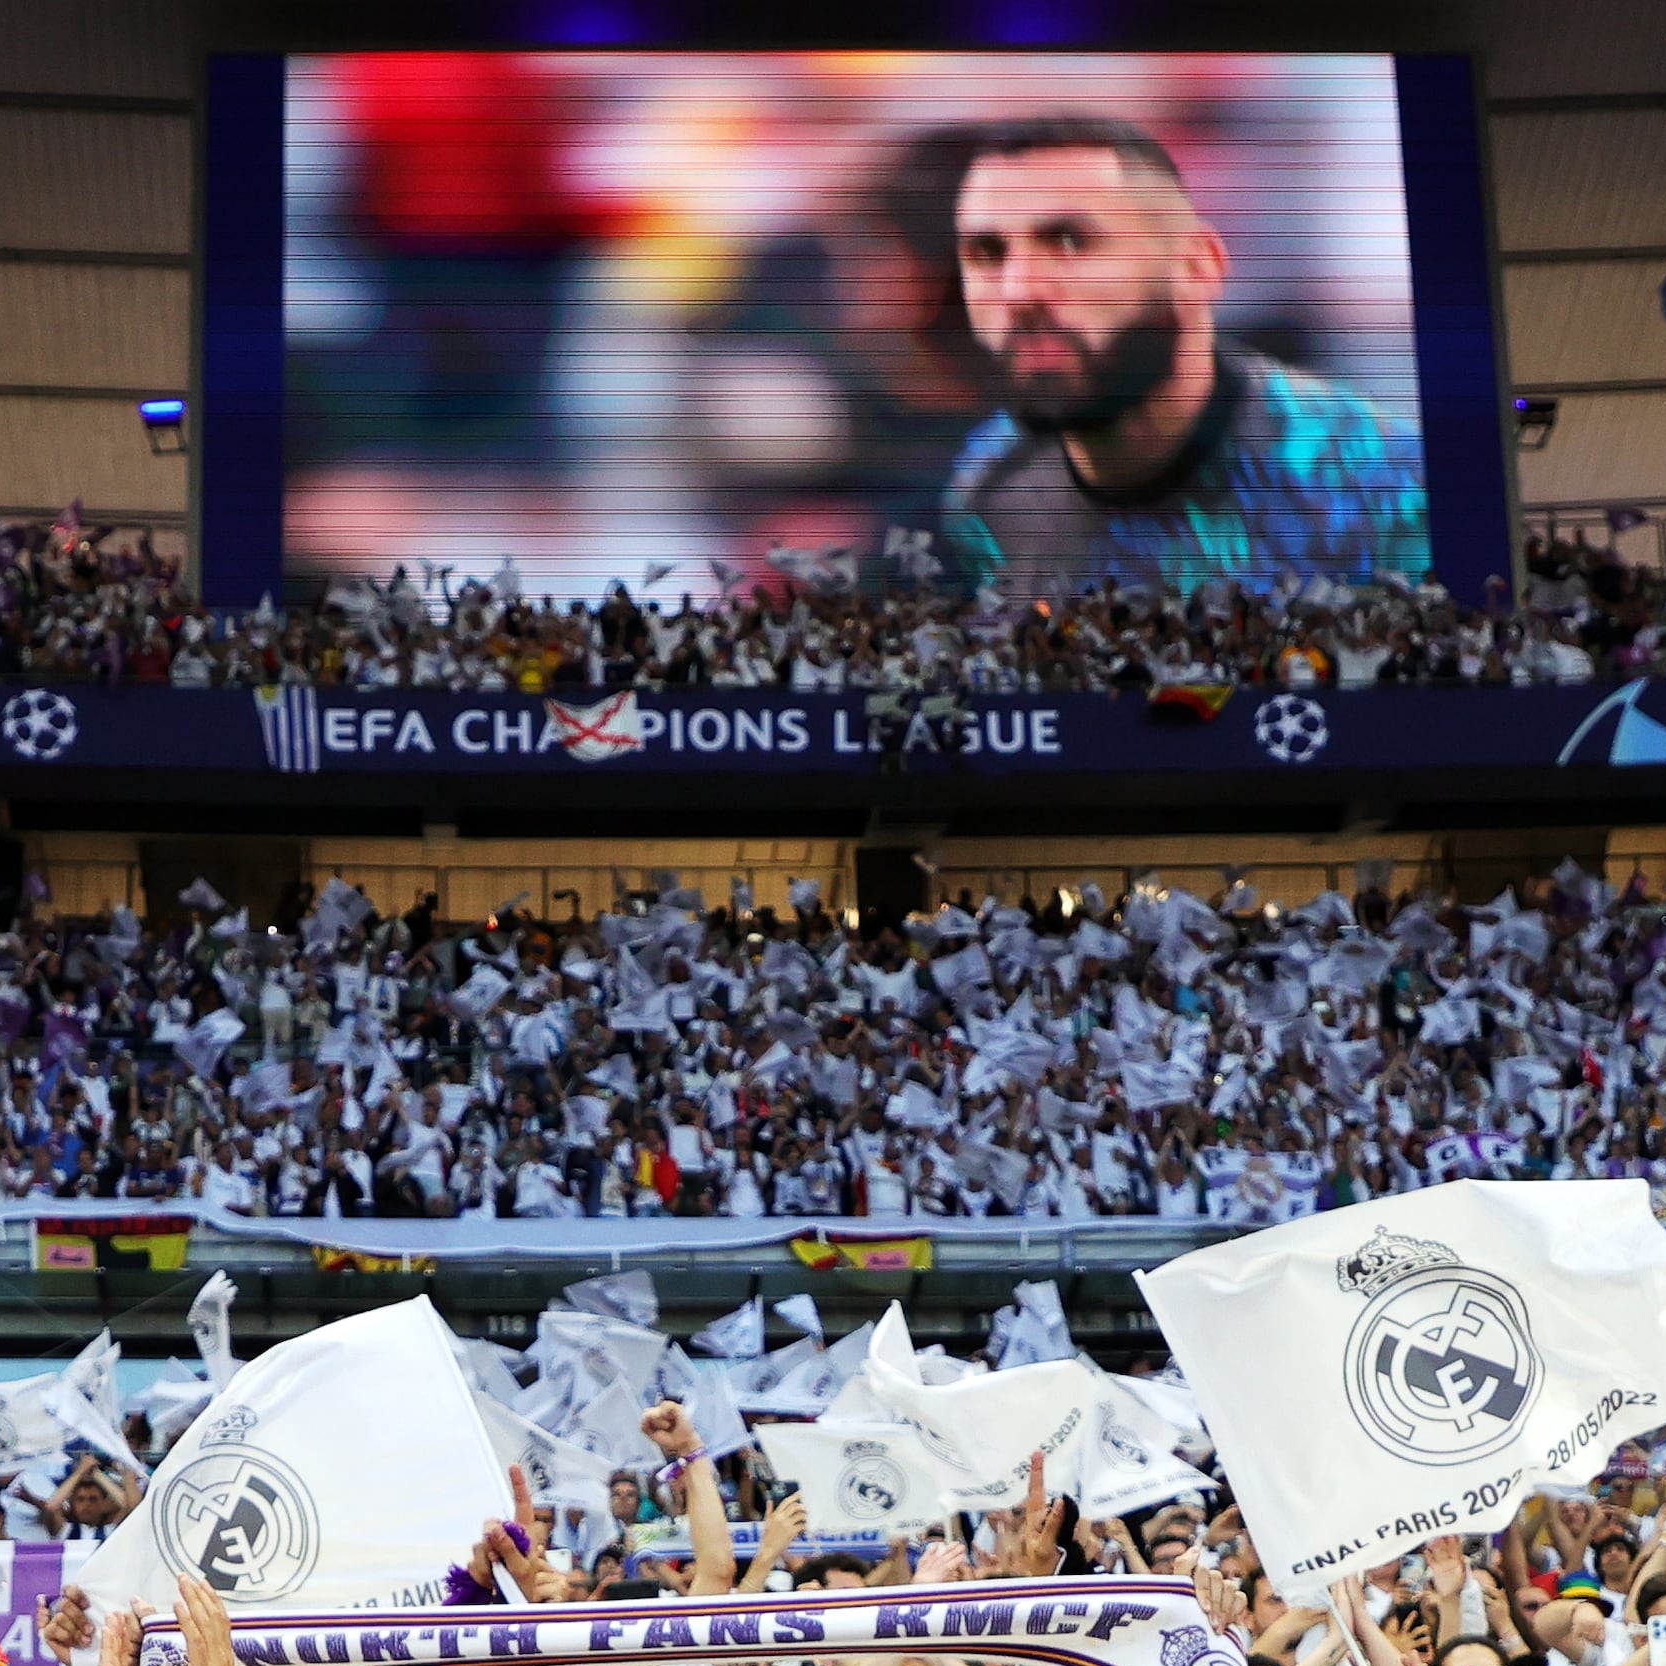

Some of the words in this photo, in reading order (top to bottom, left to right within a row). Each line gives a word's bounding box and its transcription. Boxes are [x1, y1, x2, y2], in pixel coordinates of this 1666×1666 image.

[322, 708, 435, 753] EFA
[451, 707, 811, 753] CHAPIONS
[1292, 1539, 1370, 1577] FINAL
[1375, 1500, 1459, 1541] PARIS
[1462, 1468, 1523, 1518] 2022
[1545, 1386, 1659, 1474] 28/05/2022
[590, 1608, 826, 1653] FANS
[873, 1600, 1162, 1642] RMCF
